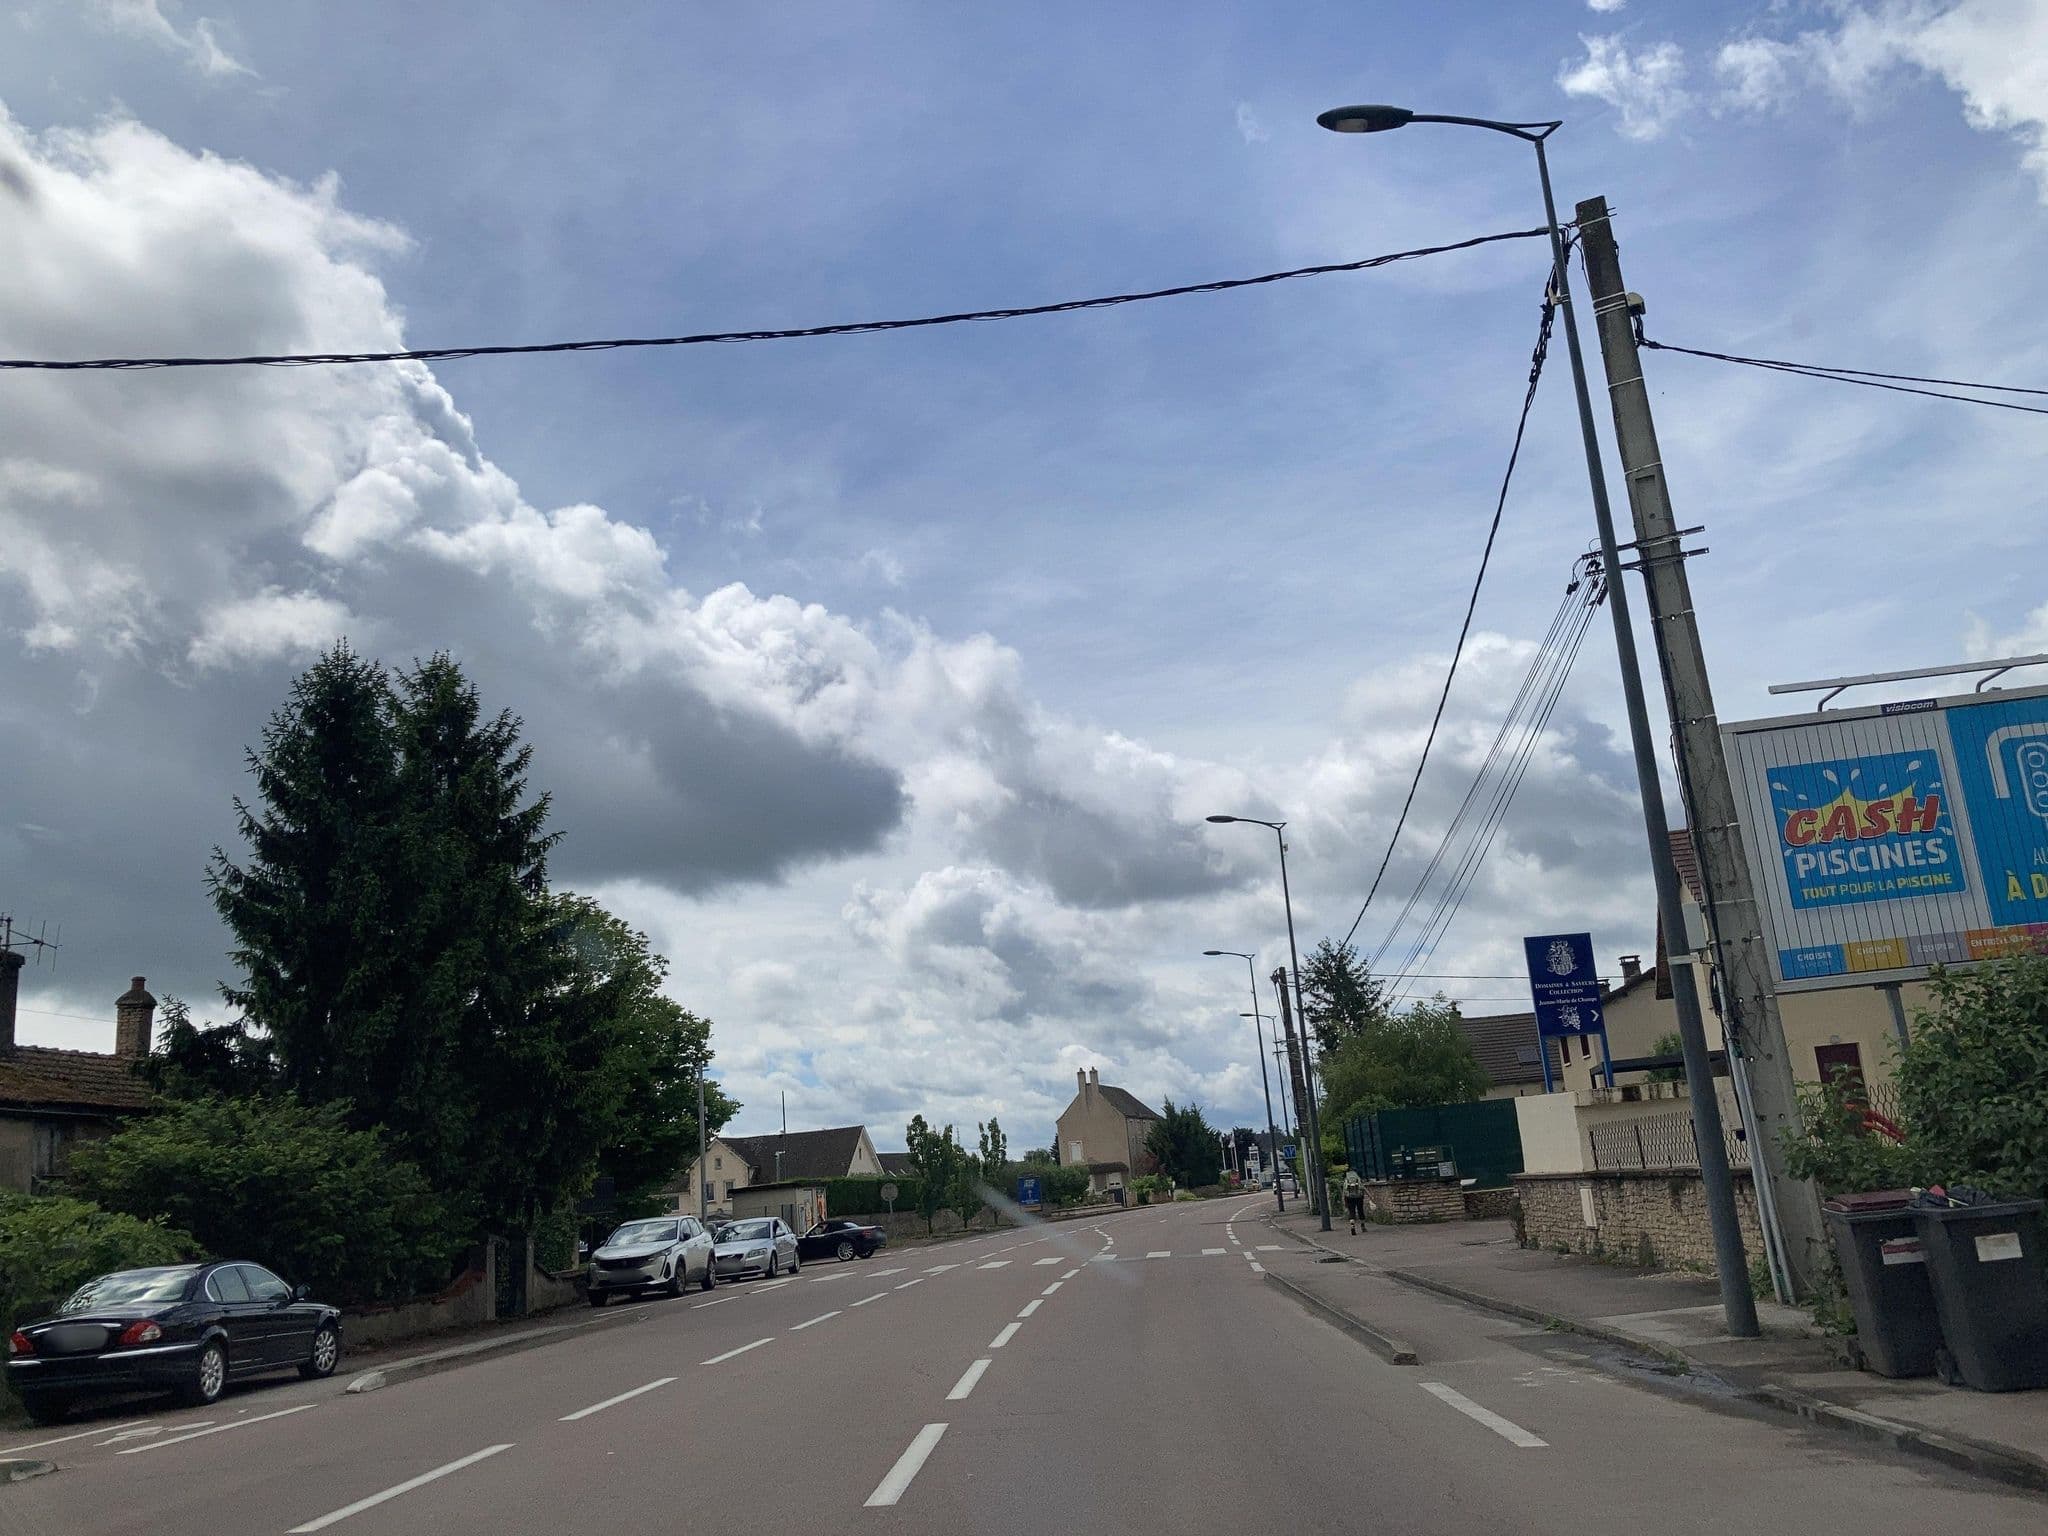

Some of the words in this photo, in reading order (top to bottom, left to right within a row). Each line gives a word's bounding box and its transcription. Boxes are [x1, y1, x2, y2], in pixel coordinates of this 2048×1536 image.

[1886, 701, 1934, 713] visiocom
[1784, 794, 1941, 847] CASH
[1795, 837, 1948, 879] PISCINES
[1802, 884, 1837, 900] TOUT
[1840, 880, 1875, 896] POUR
[1880, 879, 1896, 891] LA
[1898, 873, 1953, 889] PISCINE
[2006, 870, 2027, 902] À
